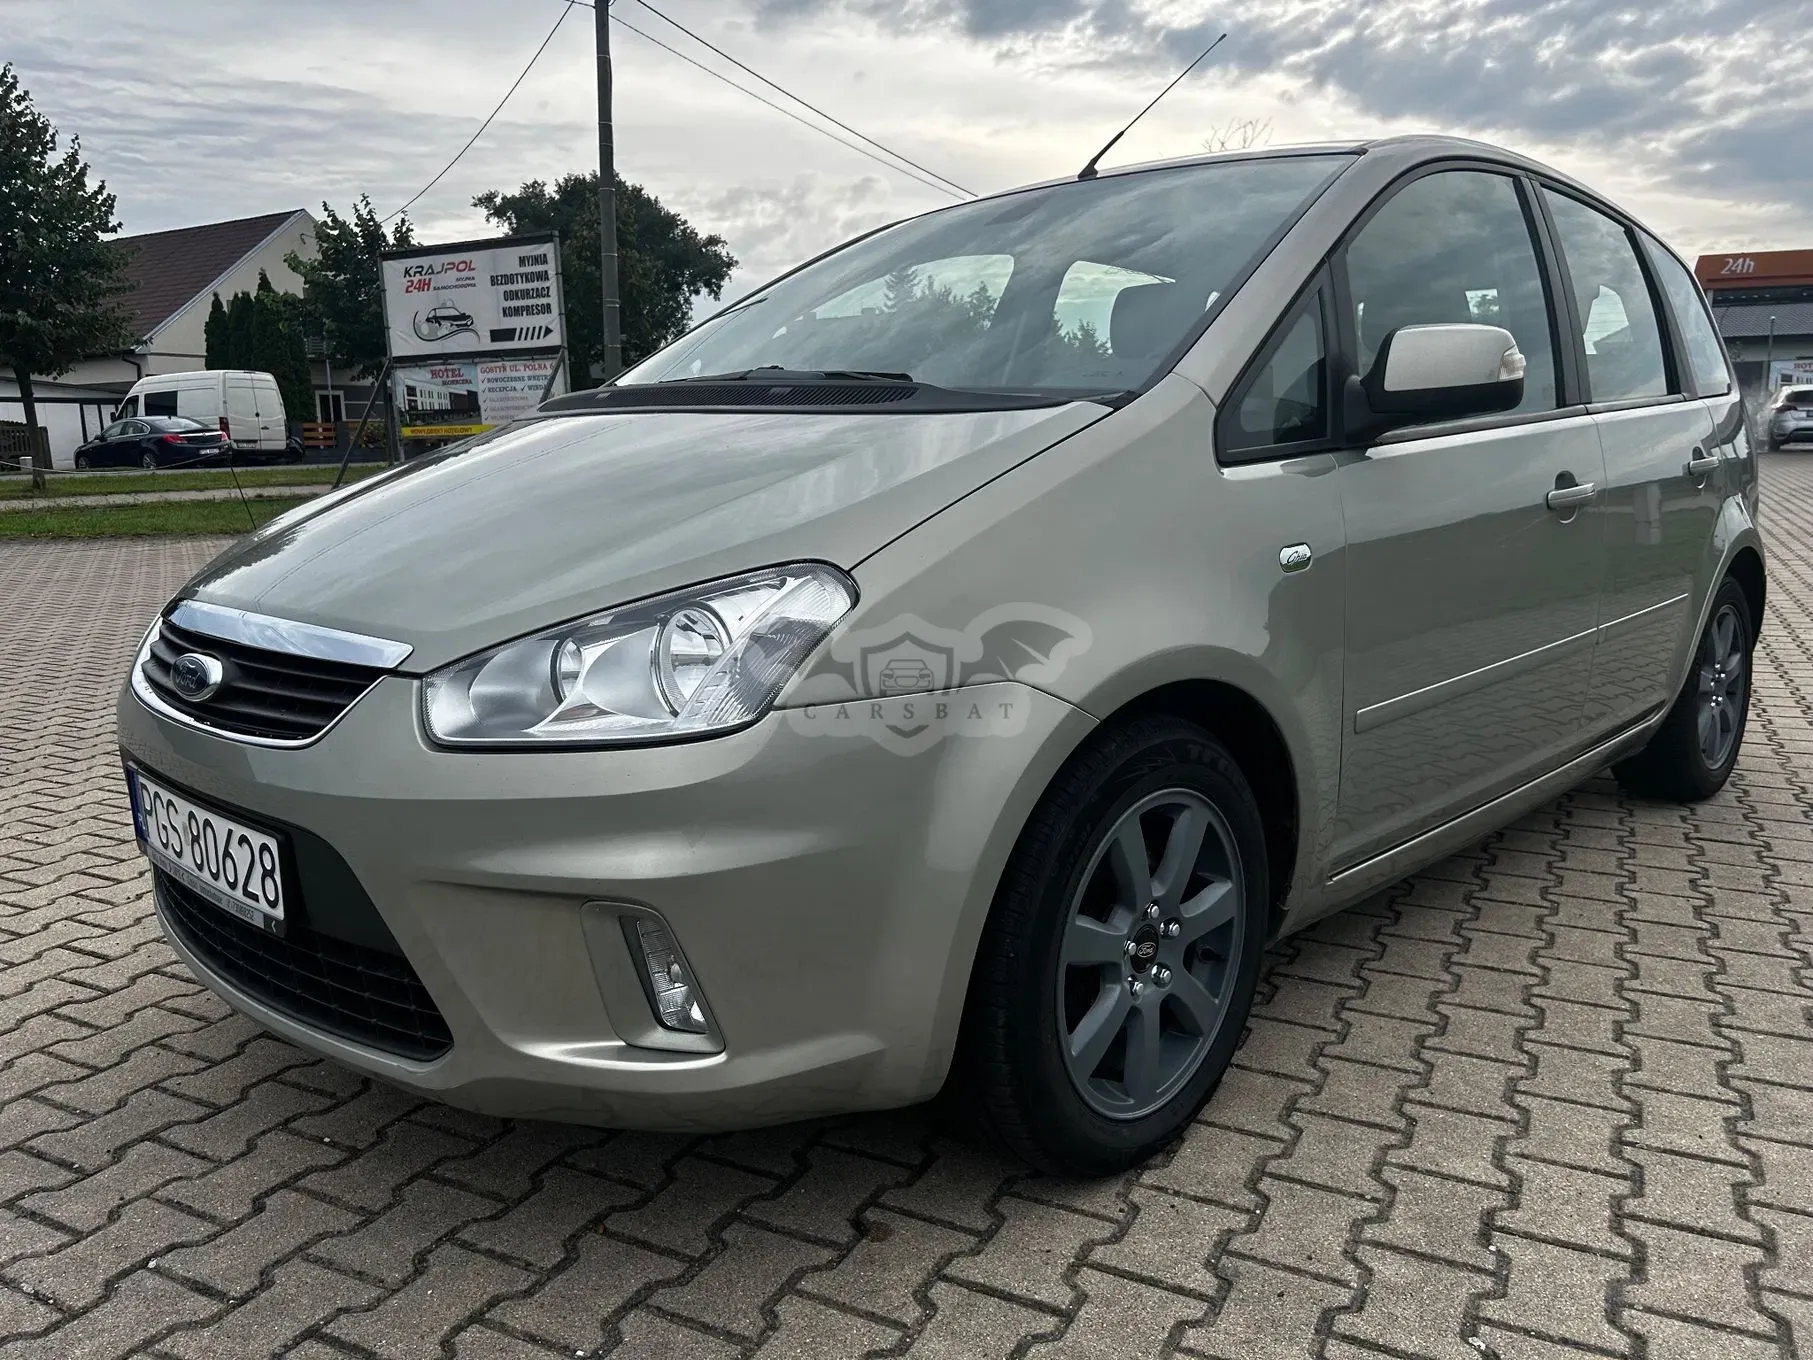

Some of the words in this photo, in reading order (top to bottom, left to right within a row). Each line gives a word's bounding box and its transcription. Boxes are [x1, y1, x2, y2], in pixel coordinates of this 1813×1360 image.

[518, 253, 548, 268] MYJNIA
[1720, 257, 1755, 273] 24h
[403, 260, 476, 278] KRAJPOL
[490, 270, 550, 286] BEZDOTYKOWA
[405, 278, 432, 294] 24H
[503, 286, 551, 301] ODKURZACZ
[502, 303, 552, 318] KOMPRESOR
[430, 367, 464, 379] HOTEL
[523, 363, 548, 372] POLNA
[488, 385, 517, 393] RECEPCJA
[139, 781, 183, 859] PGS
[187, 810, 280, 909] 80628
